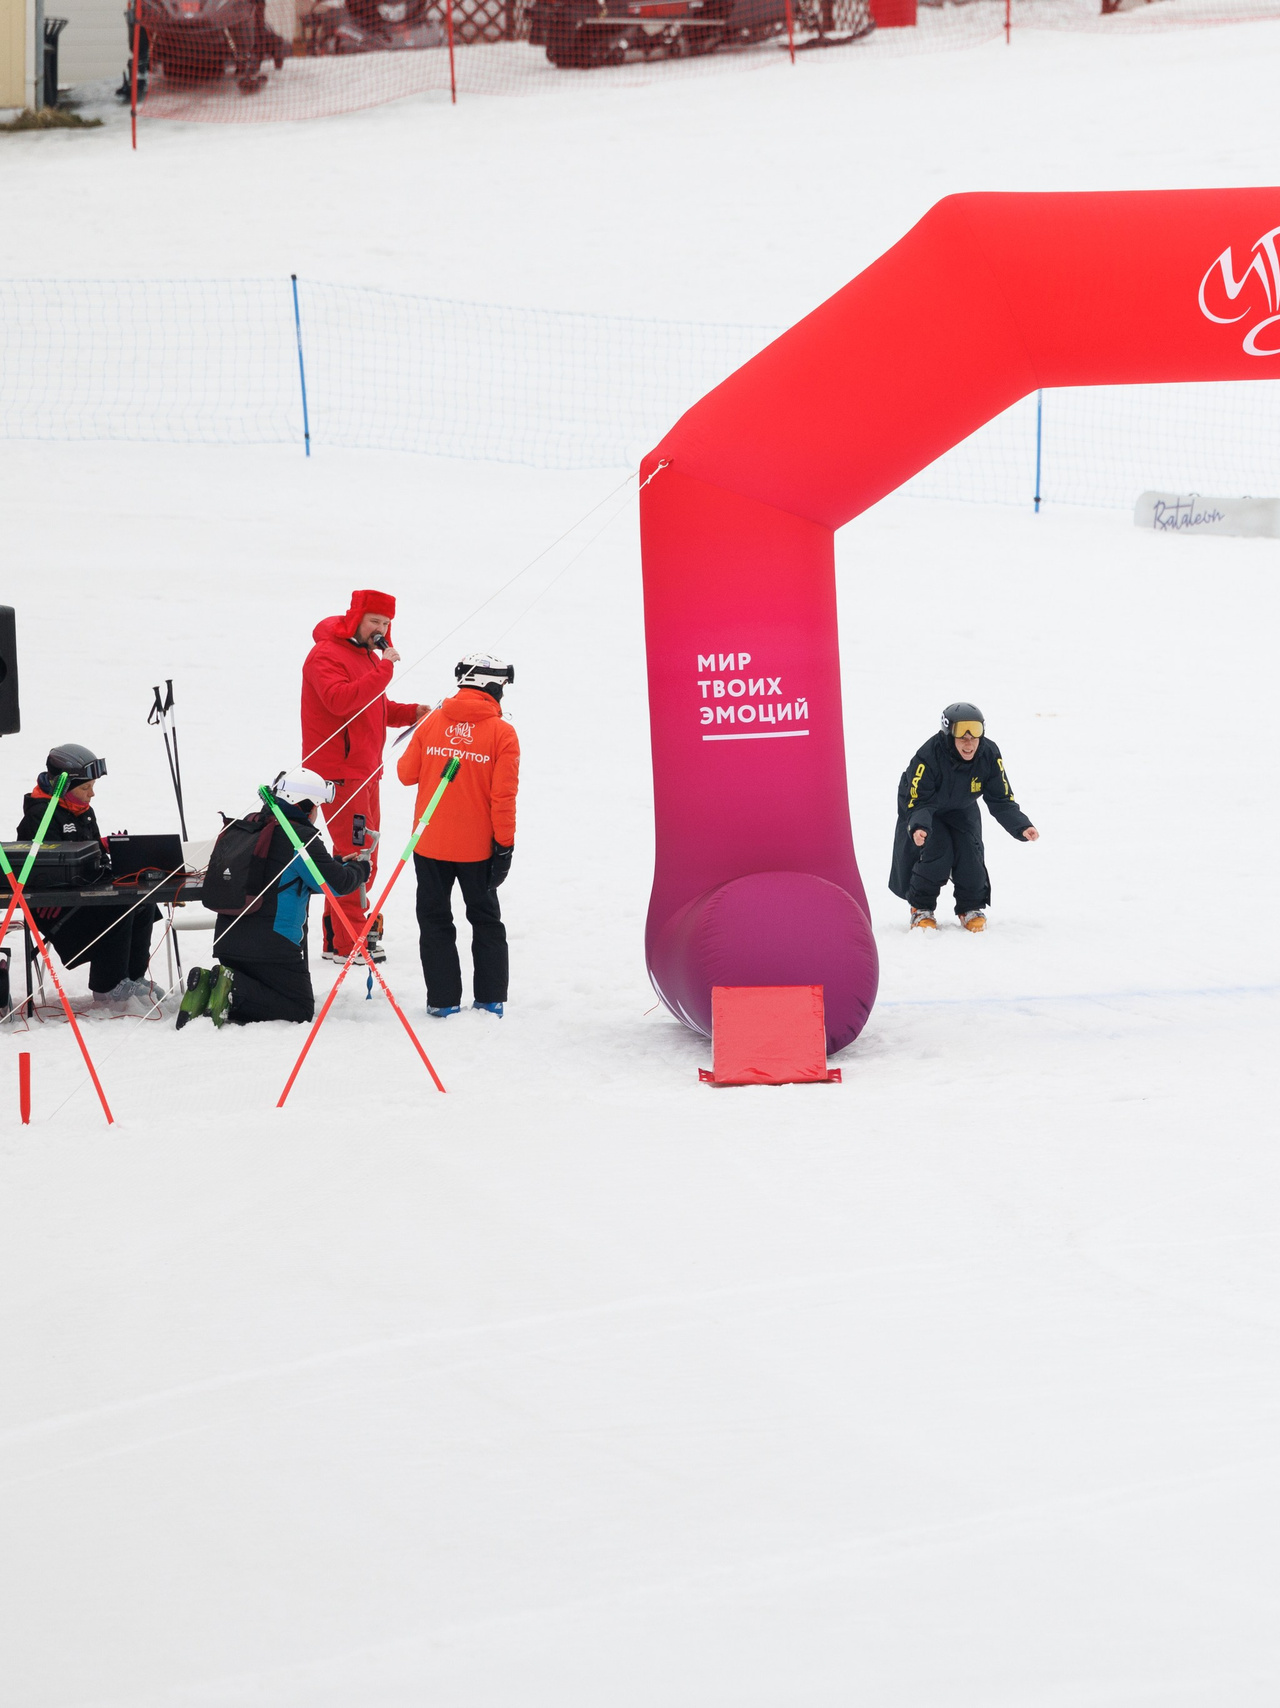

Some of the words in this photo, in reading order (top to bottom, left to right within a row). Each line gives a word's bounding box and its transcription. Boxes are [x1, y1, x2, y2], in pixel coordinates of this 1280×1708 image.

[697, 652, 752, 673] МИР
[697, 677, 783, 699] ТВОИХ
[699, 697, 809, 725] ЭМОЦИЙ
